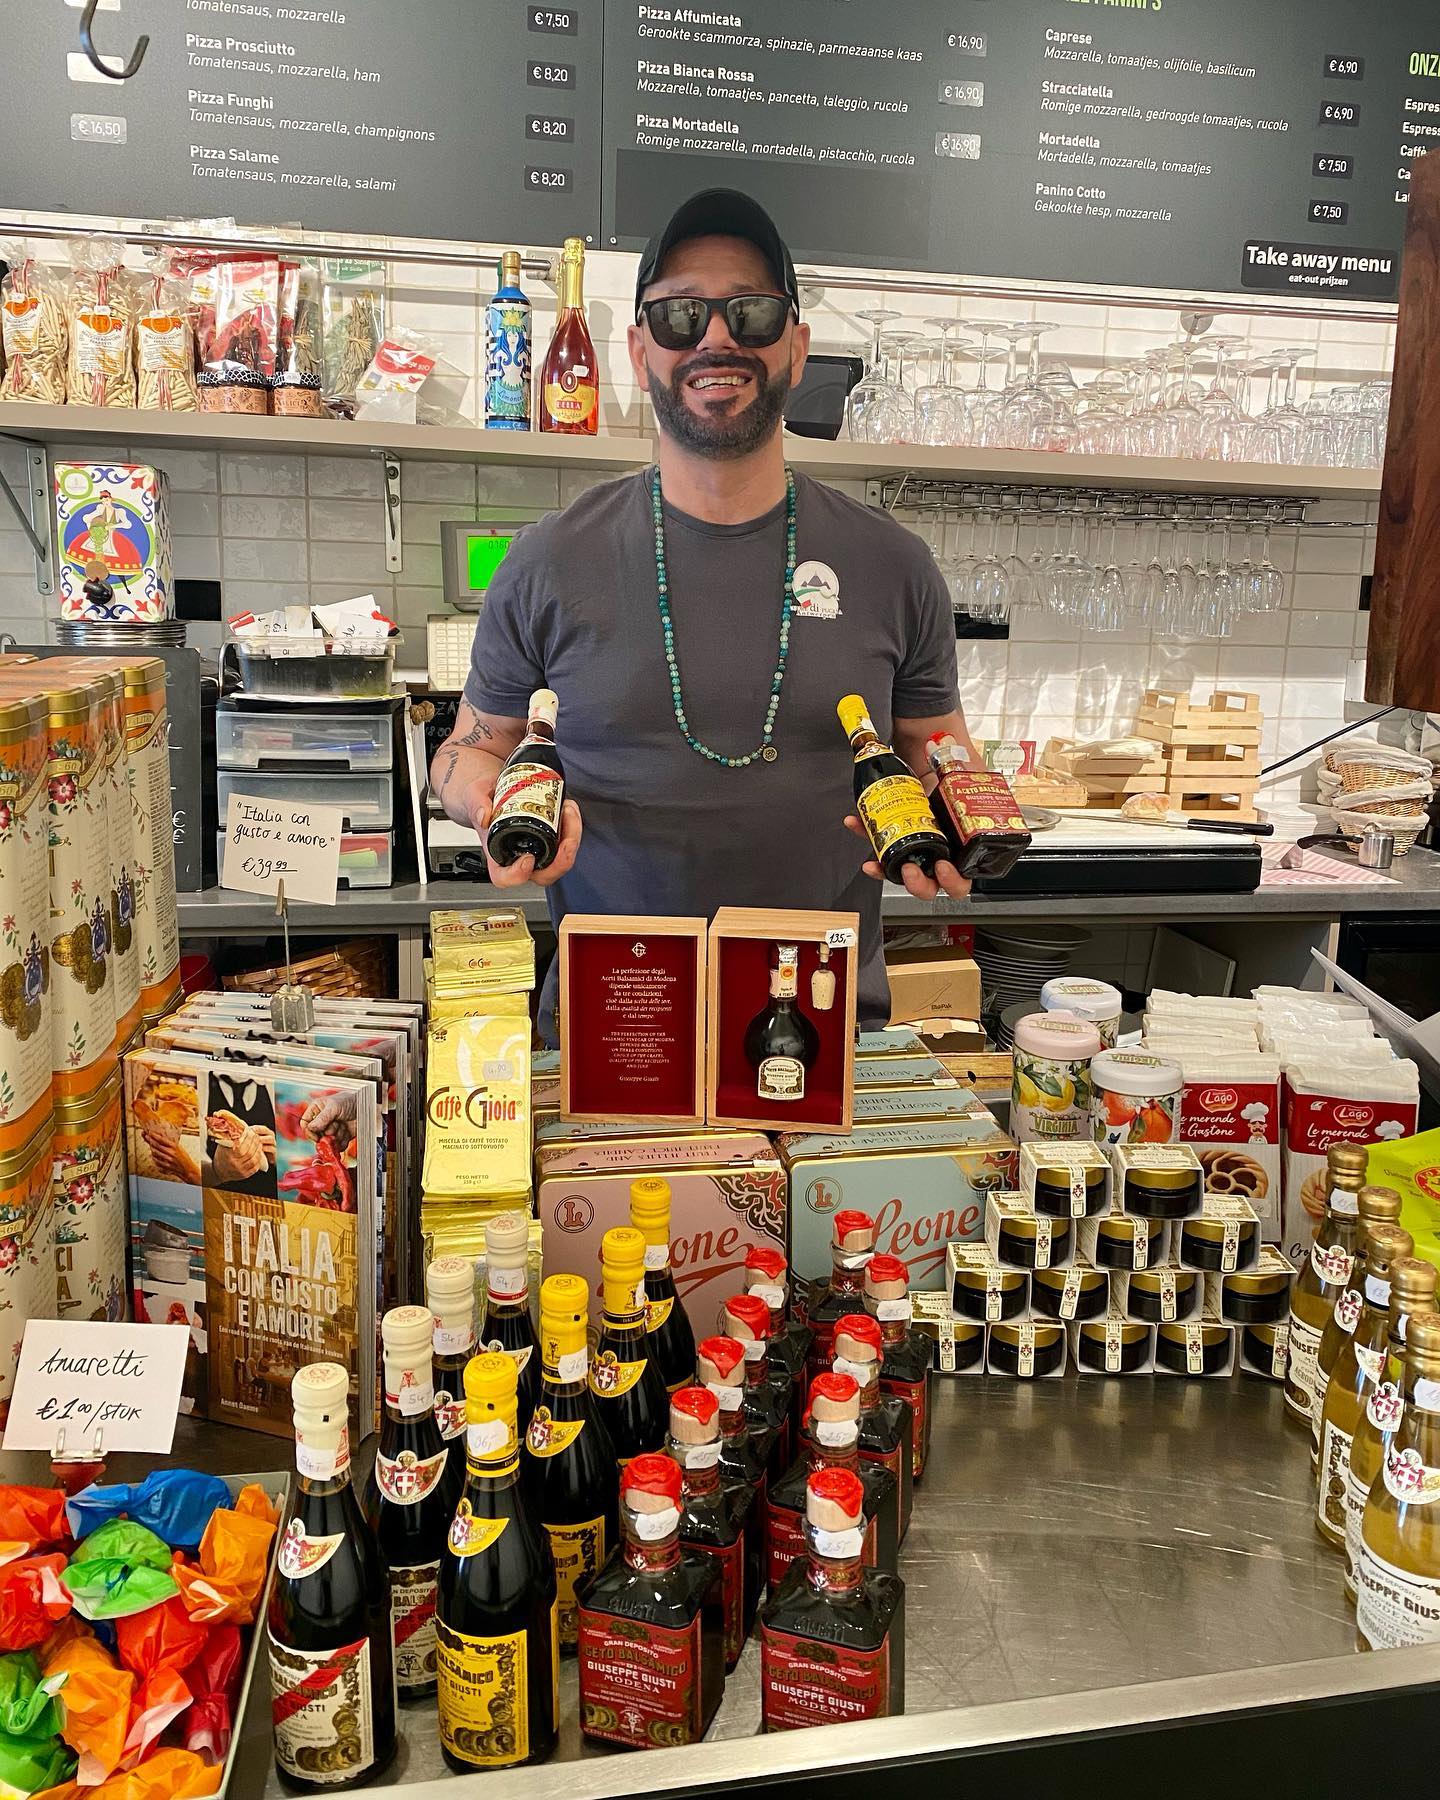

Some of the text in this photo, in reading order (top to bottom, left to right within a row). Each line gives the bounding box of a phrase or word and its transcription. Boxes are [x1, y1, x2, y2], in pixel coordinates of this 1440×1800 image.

[276, 6, 346, 24] mozzarella
[545, 13, 570, 28] 7,50
[638, 6, 742, 27] Pizza Affumicata
[186, 33, 296, 56] Pizza Prosciutto
[638, 24, 923, 62] Gerookte scammorza, spinazie, parmezaanse kaas
[958, 35, 983, 50] 16,90
[1045, 28, 1093, 45] Caprese
[188, 53, 381, 83] Tomatensaus, mozzarella, ham
[637, 60, 755, 83] Pizza Bianca Rossa
[1044, 46, 1256, 78] Mozzarella, tomaatjes, olijfolie, basilicum
[1409, 52, 1440, 77] ONZ
[544, 67, 568, 82] 8,20
[637, 78, 909, 113] Mozzarella, tomaatjes, pancetta, taleggio, rucola
[1041, 80, 1114, 99] Stracciatella
[188, 90, 274, 111] Pizza Funghi
[190, 108, 436, 142] Tomatensaus, mozzarella, champignons
[636, 114, 740, 134] Pizza Mortadella
[1041, 98, 1289, 131] Romige mozzarella, gedroogde tomaatjes, rucola
[91, 121, 121, 137] 16,50
[543, 121, 567, 136] 8,20
[636, 132, 916, 165] Romige mozzarella, mortadella, pistacchio, rucola
[1039, 131, 1101, 149] Mortadella
[190, 145, 280, 165] Pizza Salame
[1038, 149, 1212, 177] Mortadella, mozzarella, tomaatjes
[191, 164, 396, 192] Tomatensaus, mozzarella, salami
[541, 172, 565, 187] 8,20
[1035, 182, 1106, 200] Panino Cotto
[1034, 200, 1172, 222] Gekookte hesp, mozzarella
[1247, 246, 1392, 274] Take away menu
[1289, 274, 1349, 287] eat-out prijzen
[291, 812, 311, 826] con
[233, 824, 271, 845] gusto
[273, 831, 282, 840] e
[425, 1086, 462, 1130] Caffè
[1204, 1091, 1233, 1105] Lago
[1189, 1112, 1236, 1123] merende
[1339, 1107, 1369, 1120] Lago
[1033, 1116, 1078, 1133] VIRGINIA
[1187, 1123, 1236, 1137] Gastone
[1307, 1122, 1370, 1139] Le merende
[223, 1213, 337, 1284] ITALIA
[224, 1265, 338, 1315] CON GUSTO
[237, 1299, 250, 1327] E
[38, 1347, 149, 1377] Amaretti
[624, 1641, 659, 1659] DEPOSITO
[587, 1660, 676, 1690] GIUSEPPE GIUSTI
[788, 1661, 847, 1682] GRAN DEPOSITO
[449, 1680, 482, 1697] GIUSTI
[604, 1674, 660, 1694] MODENA
[770, 1681, 865, 1714] GIUSEPPE GIUSTI
[788, 1696, 849, 1717] MODENA
